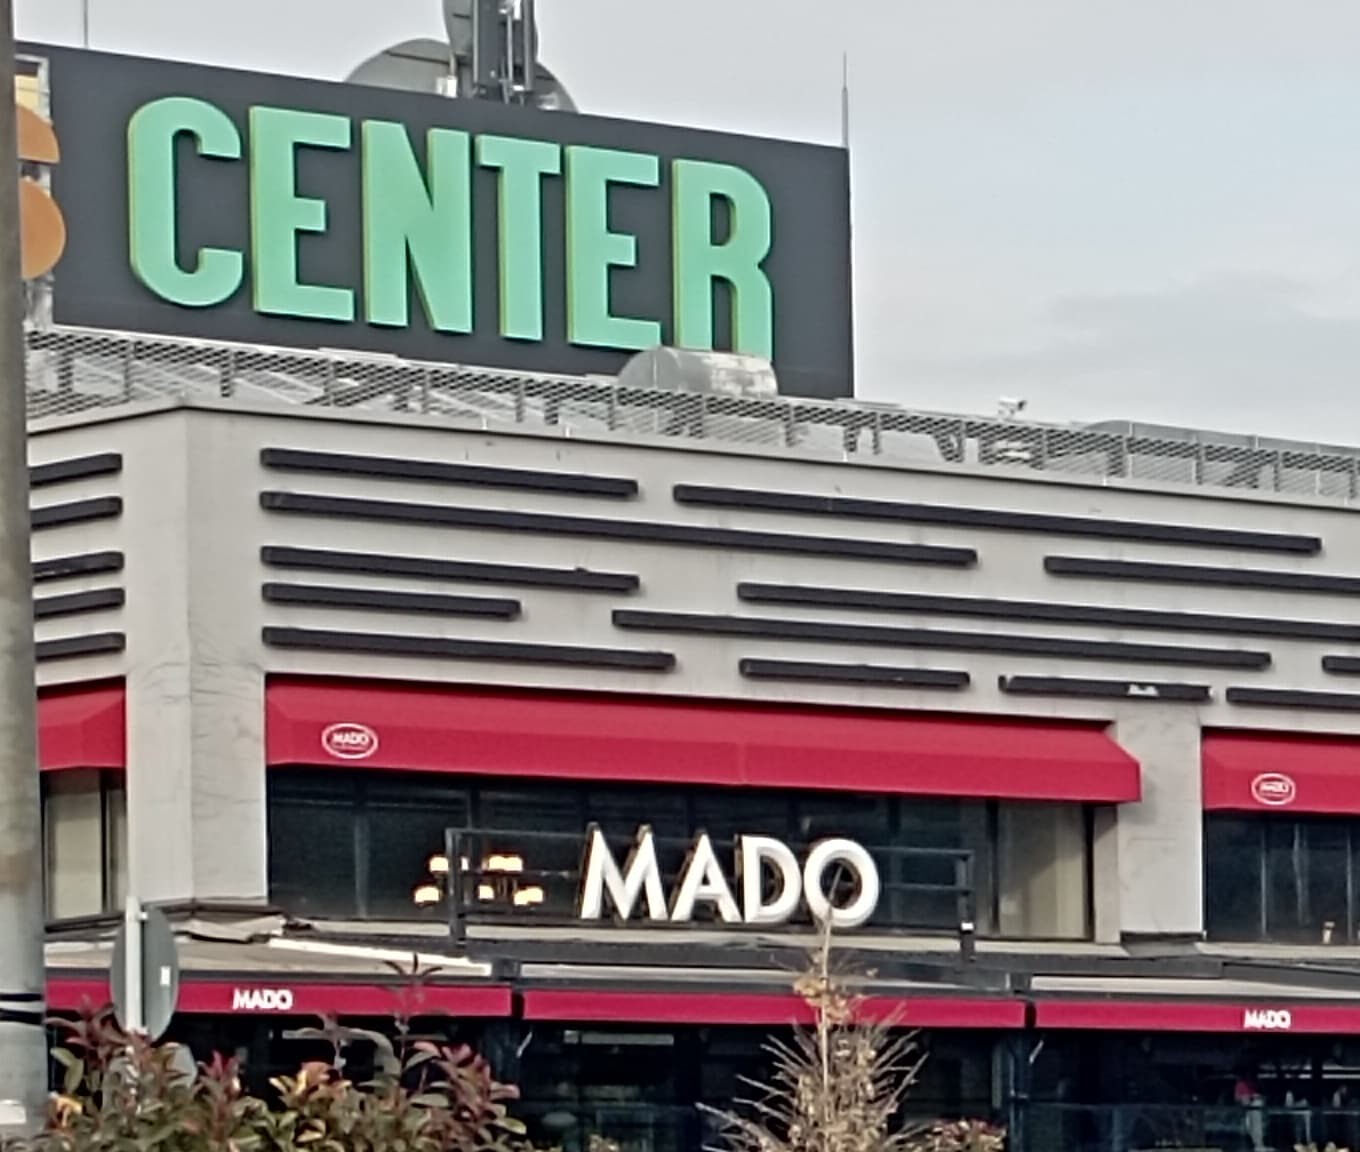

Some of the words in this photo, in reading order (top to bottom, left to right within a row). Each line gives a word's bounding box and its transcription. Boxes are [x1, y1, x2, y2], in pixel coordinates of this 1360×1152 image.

[127, 97, 774, 360] CENTER
[577, 822, 881, 929] MADO
[232, 988, 293, 1010] MADO
[1244, 1008, 1291, 1029] MADO
